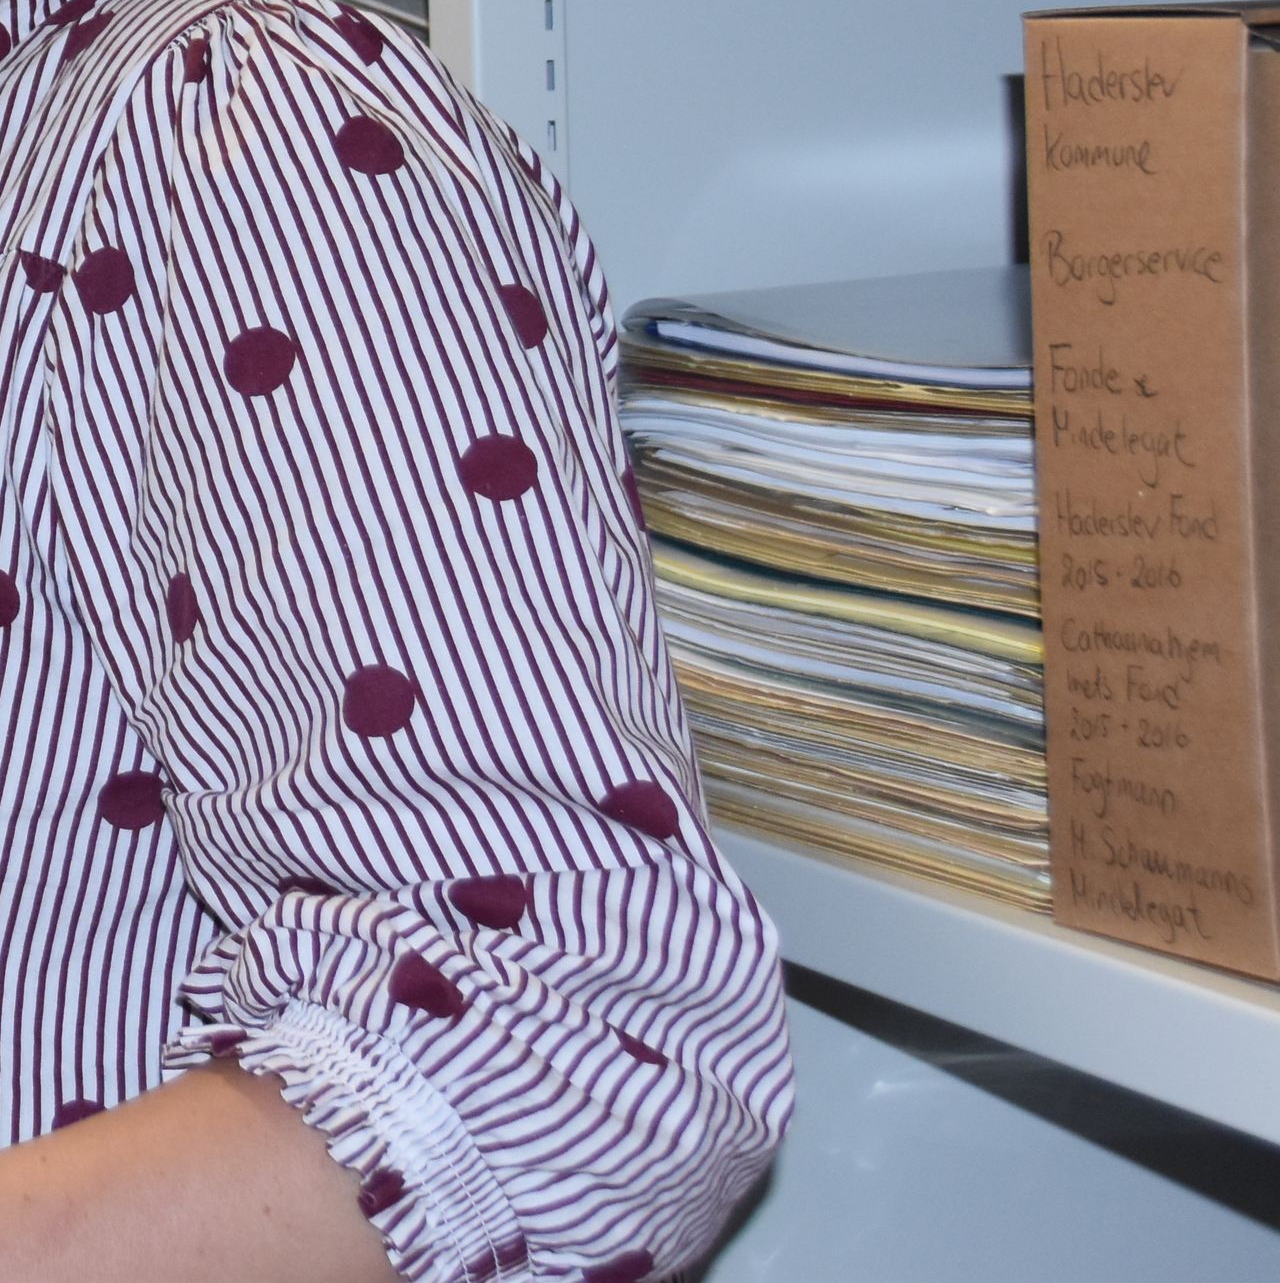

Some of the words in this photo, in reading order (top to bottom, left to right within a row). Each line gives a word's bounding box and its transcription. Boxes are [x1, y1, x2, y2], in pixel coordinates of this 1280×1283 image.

[1041, 34, 1185, 111] Haderslev
[1044, 123, 1158, 176] Kommune
[1046, 229, 1224, 306] Borgerservice
[1048, 342, 1123, 395] Fonde
[1051, 404, 1197, 489] Mindelegat
[1056, 487, 1161, 540] Haderslev
[1168, 493, 1220, 542] Fond
[1060, 551, 1110, 591] 2015
[1129, 553, 1183, 591] 2016
[1069, 706, 1113, 742] 2015
[1136, 717, 1191, 749] 2016
